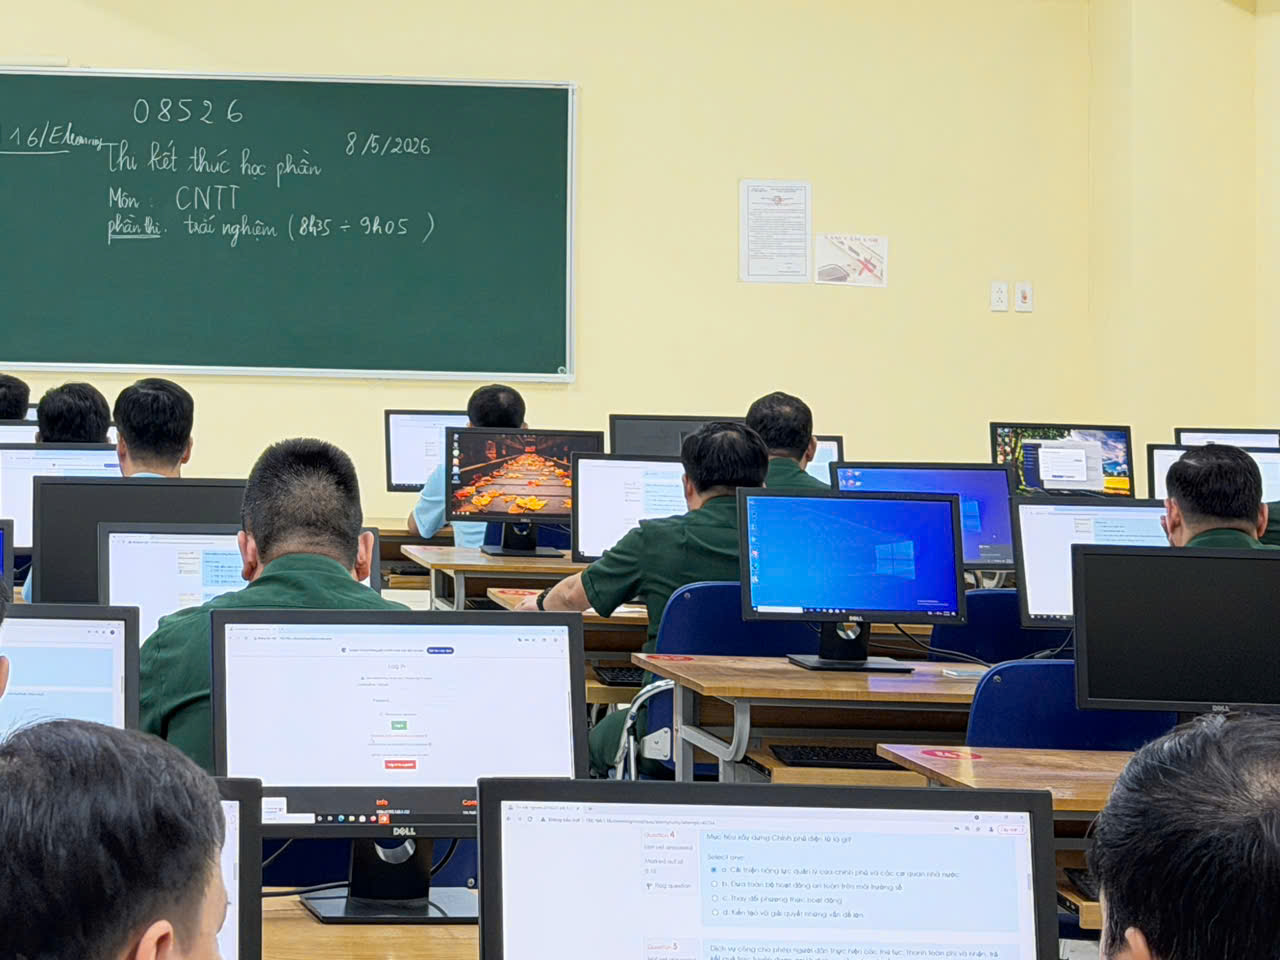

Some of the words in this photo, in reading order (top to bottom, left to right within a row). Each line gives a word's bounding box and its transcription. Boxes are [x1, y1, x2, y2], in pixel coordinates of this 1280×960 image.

[133, 98, 244, 124] 08526
[103, 140, 137, 172] Thi
[150, 139, 178, 173] kết
[240, 147, 267, 180] học
[276, 148, 322, 188] phần
[176, 184, 240, 211] CNTT
[107, 213, 141, 246] phần
[222, 214, 278, 248] nghiệm
[359, 215, 409, 236] 9h05
[392, 826, 417, 837] DELL
